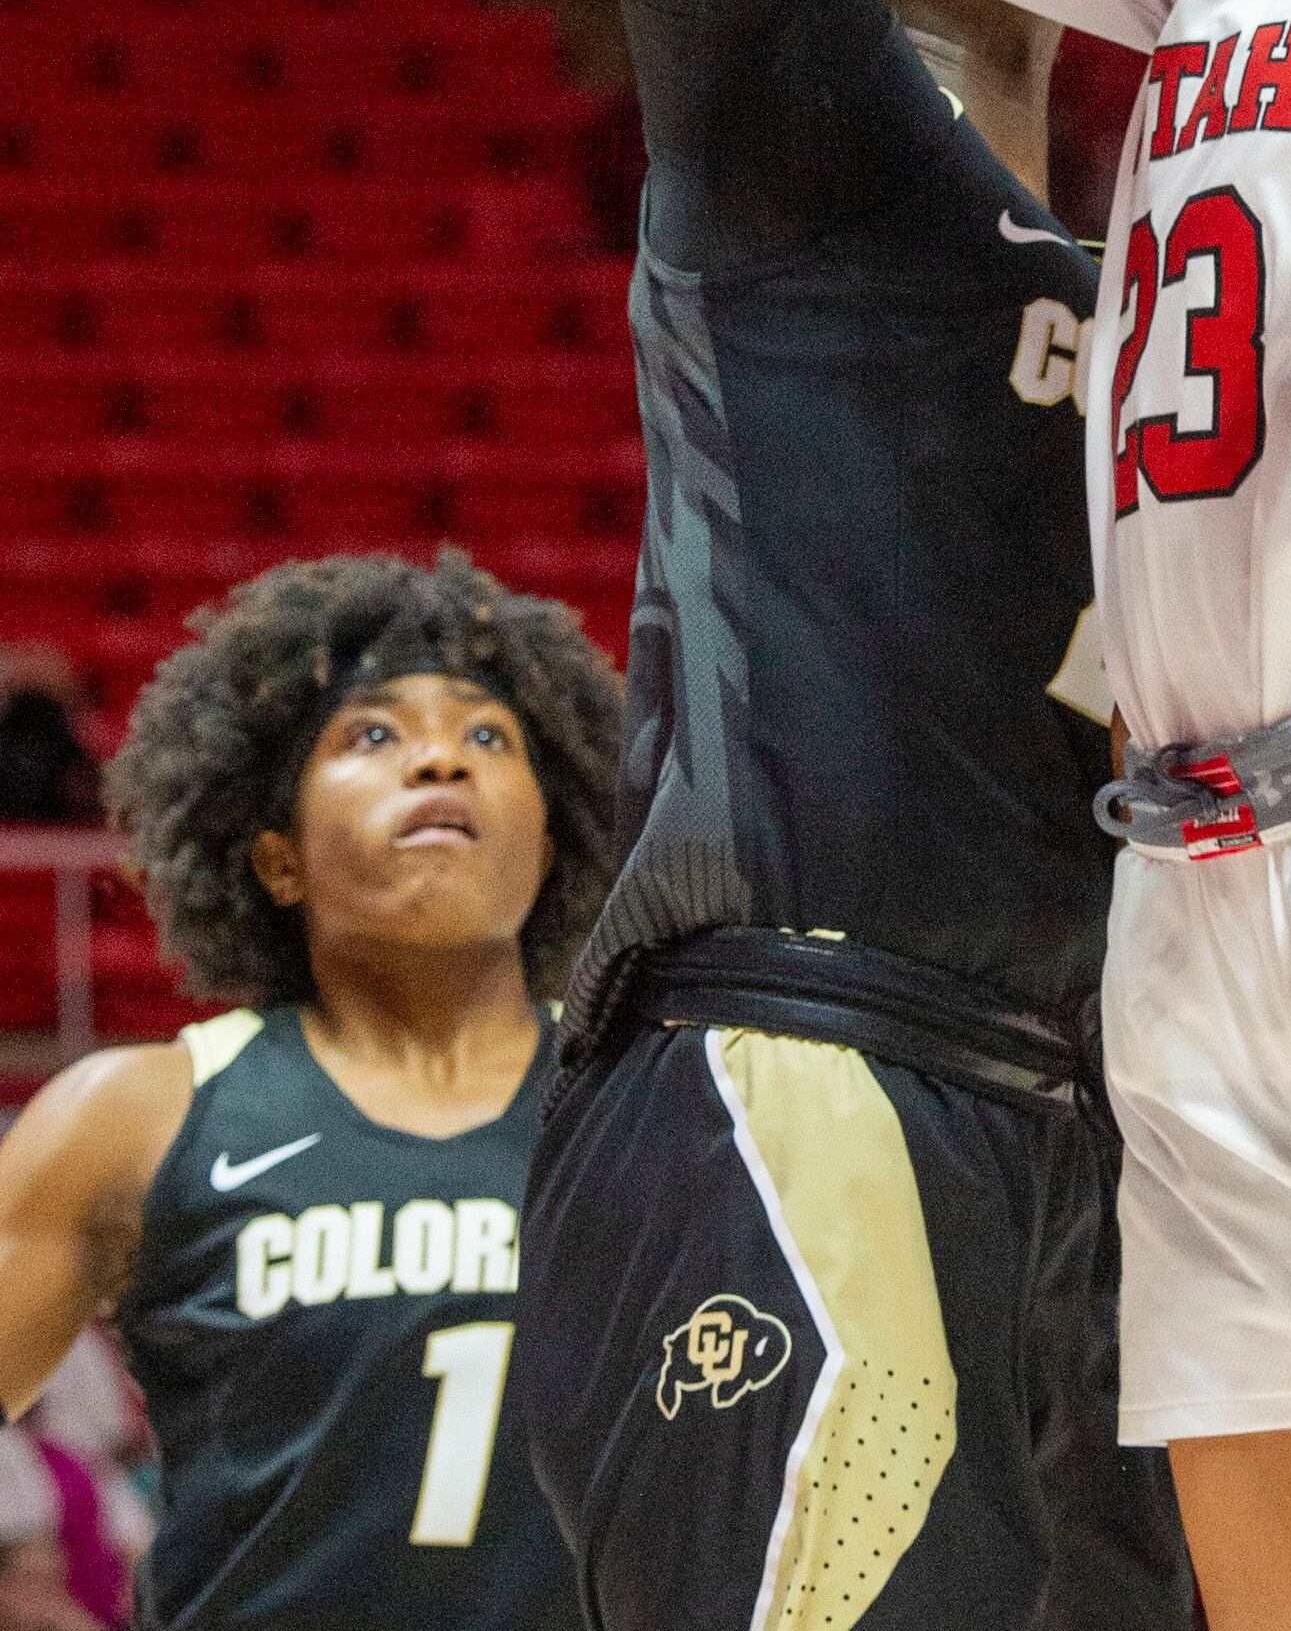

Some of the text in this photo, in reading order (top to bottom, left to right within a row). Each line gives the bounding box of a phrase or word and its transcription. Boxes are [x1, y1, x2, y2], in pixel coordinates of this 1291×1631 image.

[1008, 297, 1096, 418] C
[1111, 184, 1266, 522] 23
[235, 1197, 521, 1320] COLOR
[409, 1320, 517, 1548] 1
